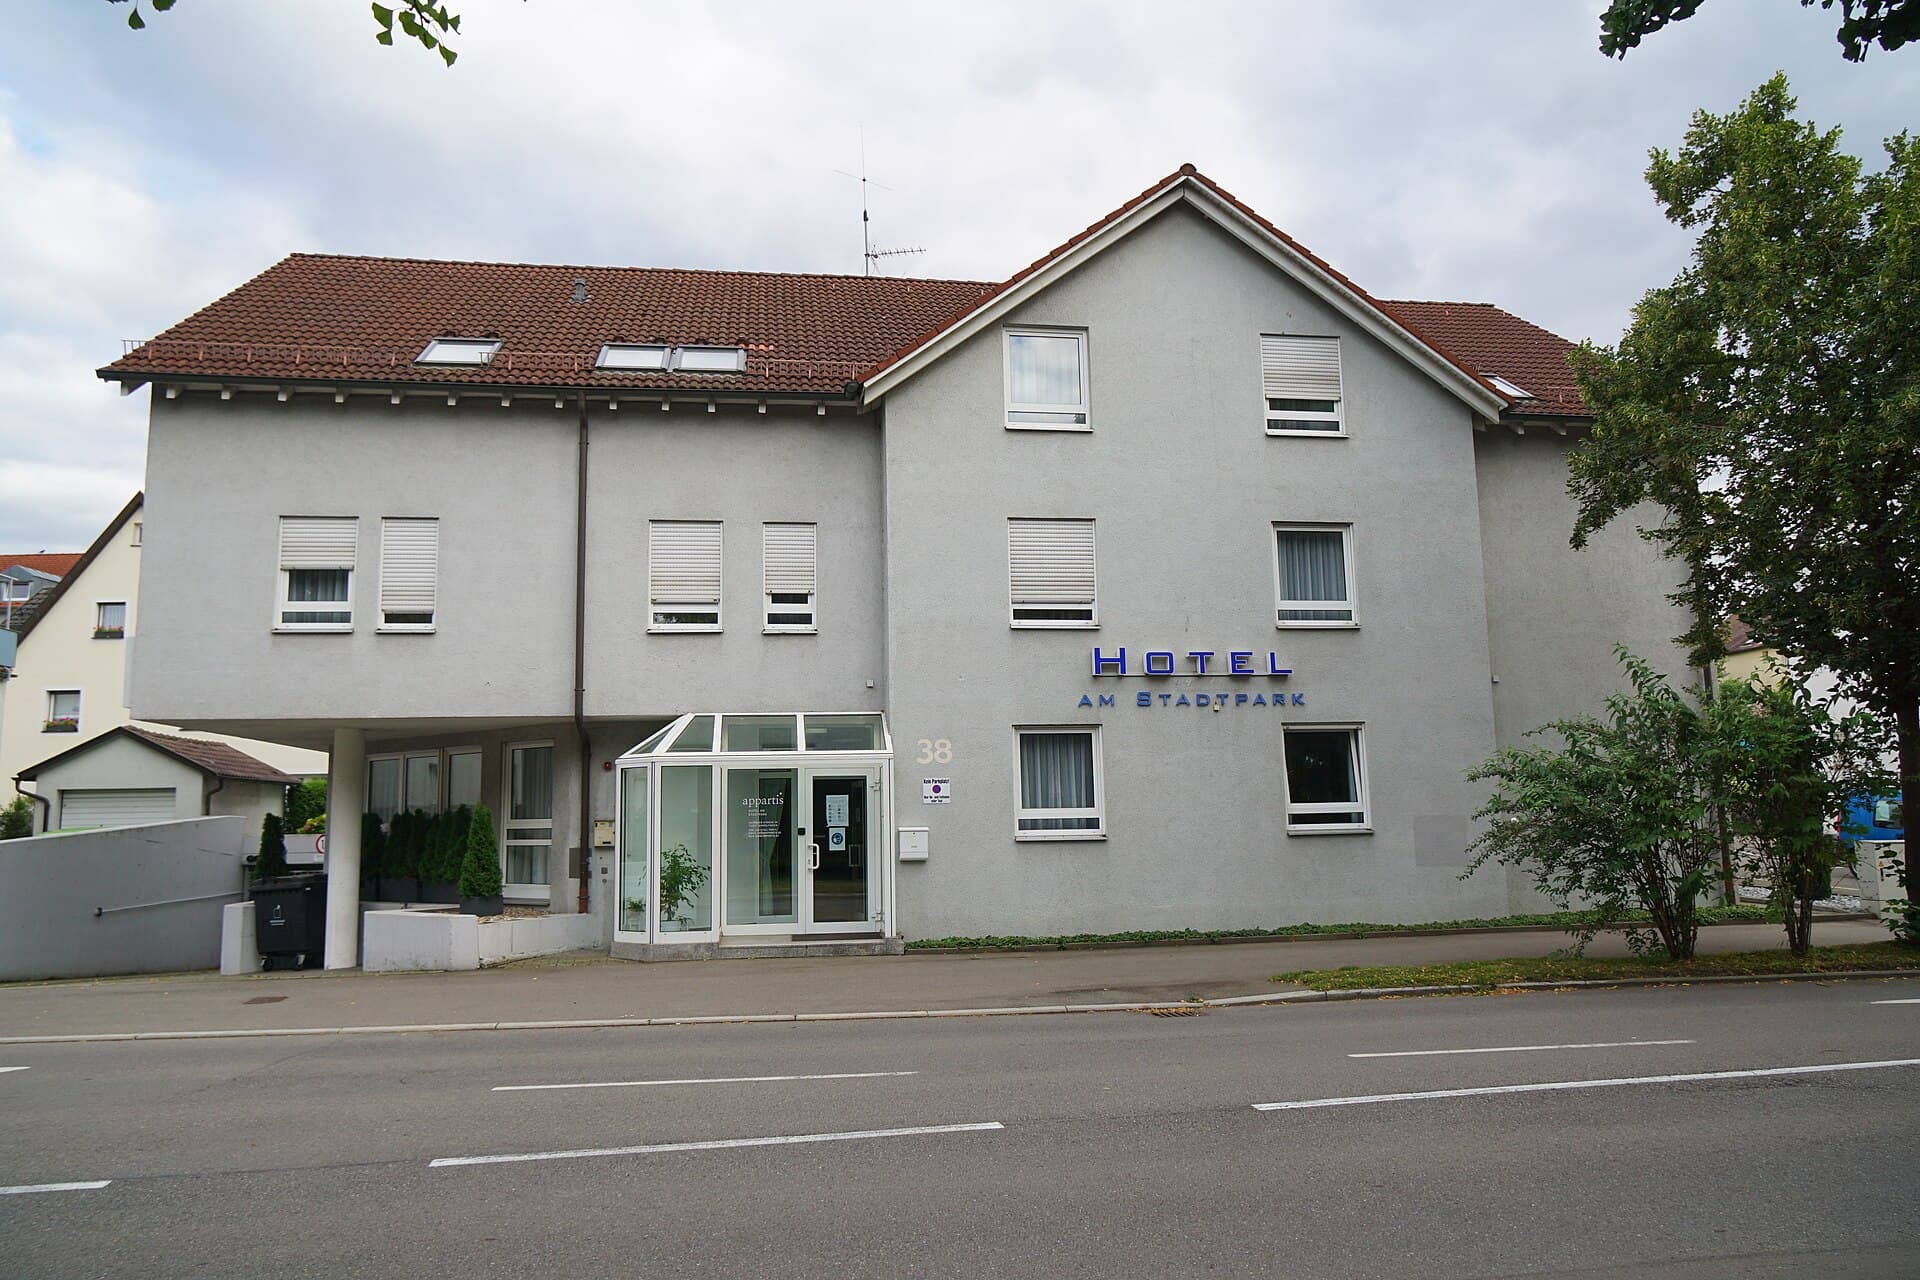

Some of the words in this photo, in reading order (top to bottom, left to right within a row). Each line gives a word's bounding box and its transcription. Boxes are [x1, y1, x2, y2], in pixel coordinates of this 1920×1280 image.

[1092, 647, 1293, 675] HOTEL
[1078, 694, 1115, 708] AM
[1136, 691, 1306, 707] STADTPARK
[916, 738, 953, 764] 38
[742, 793, 784, 808] appartis
